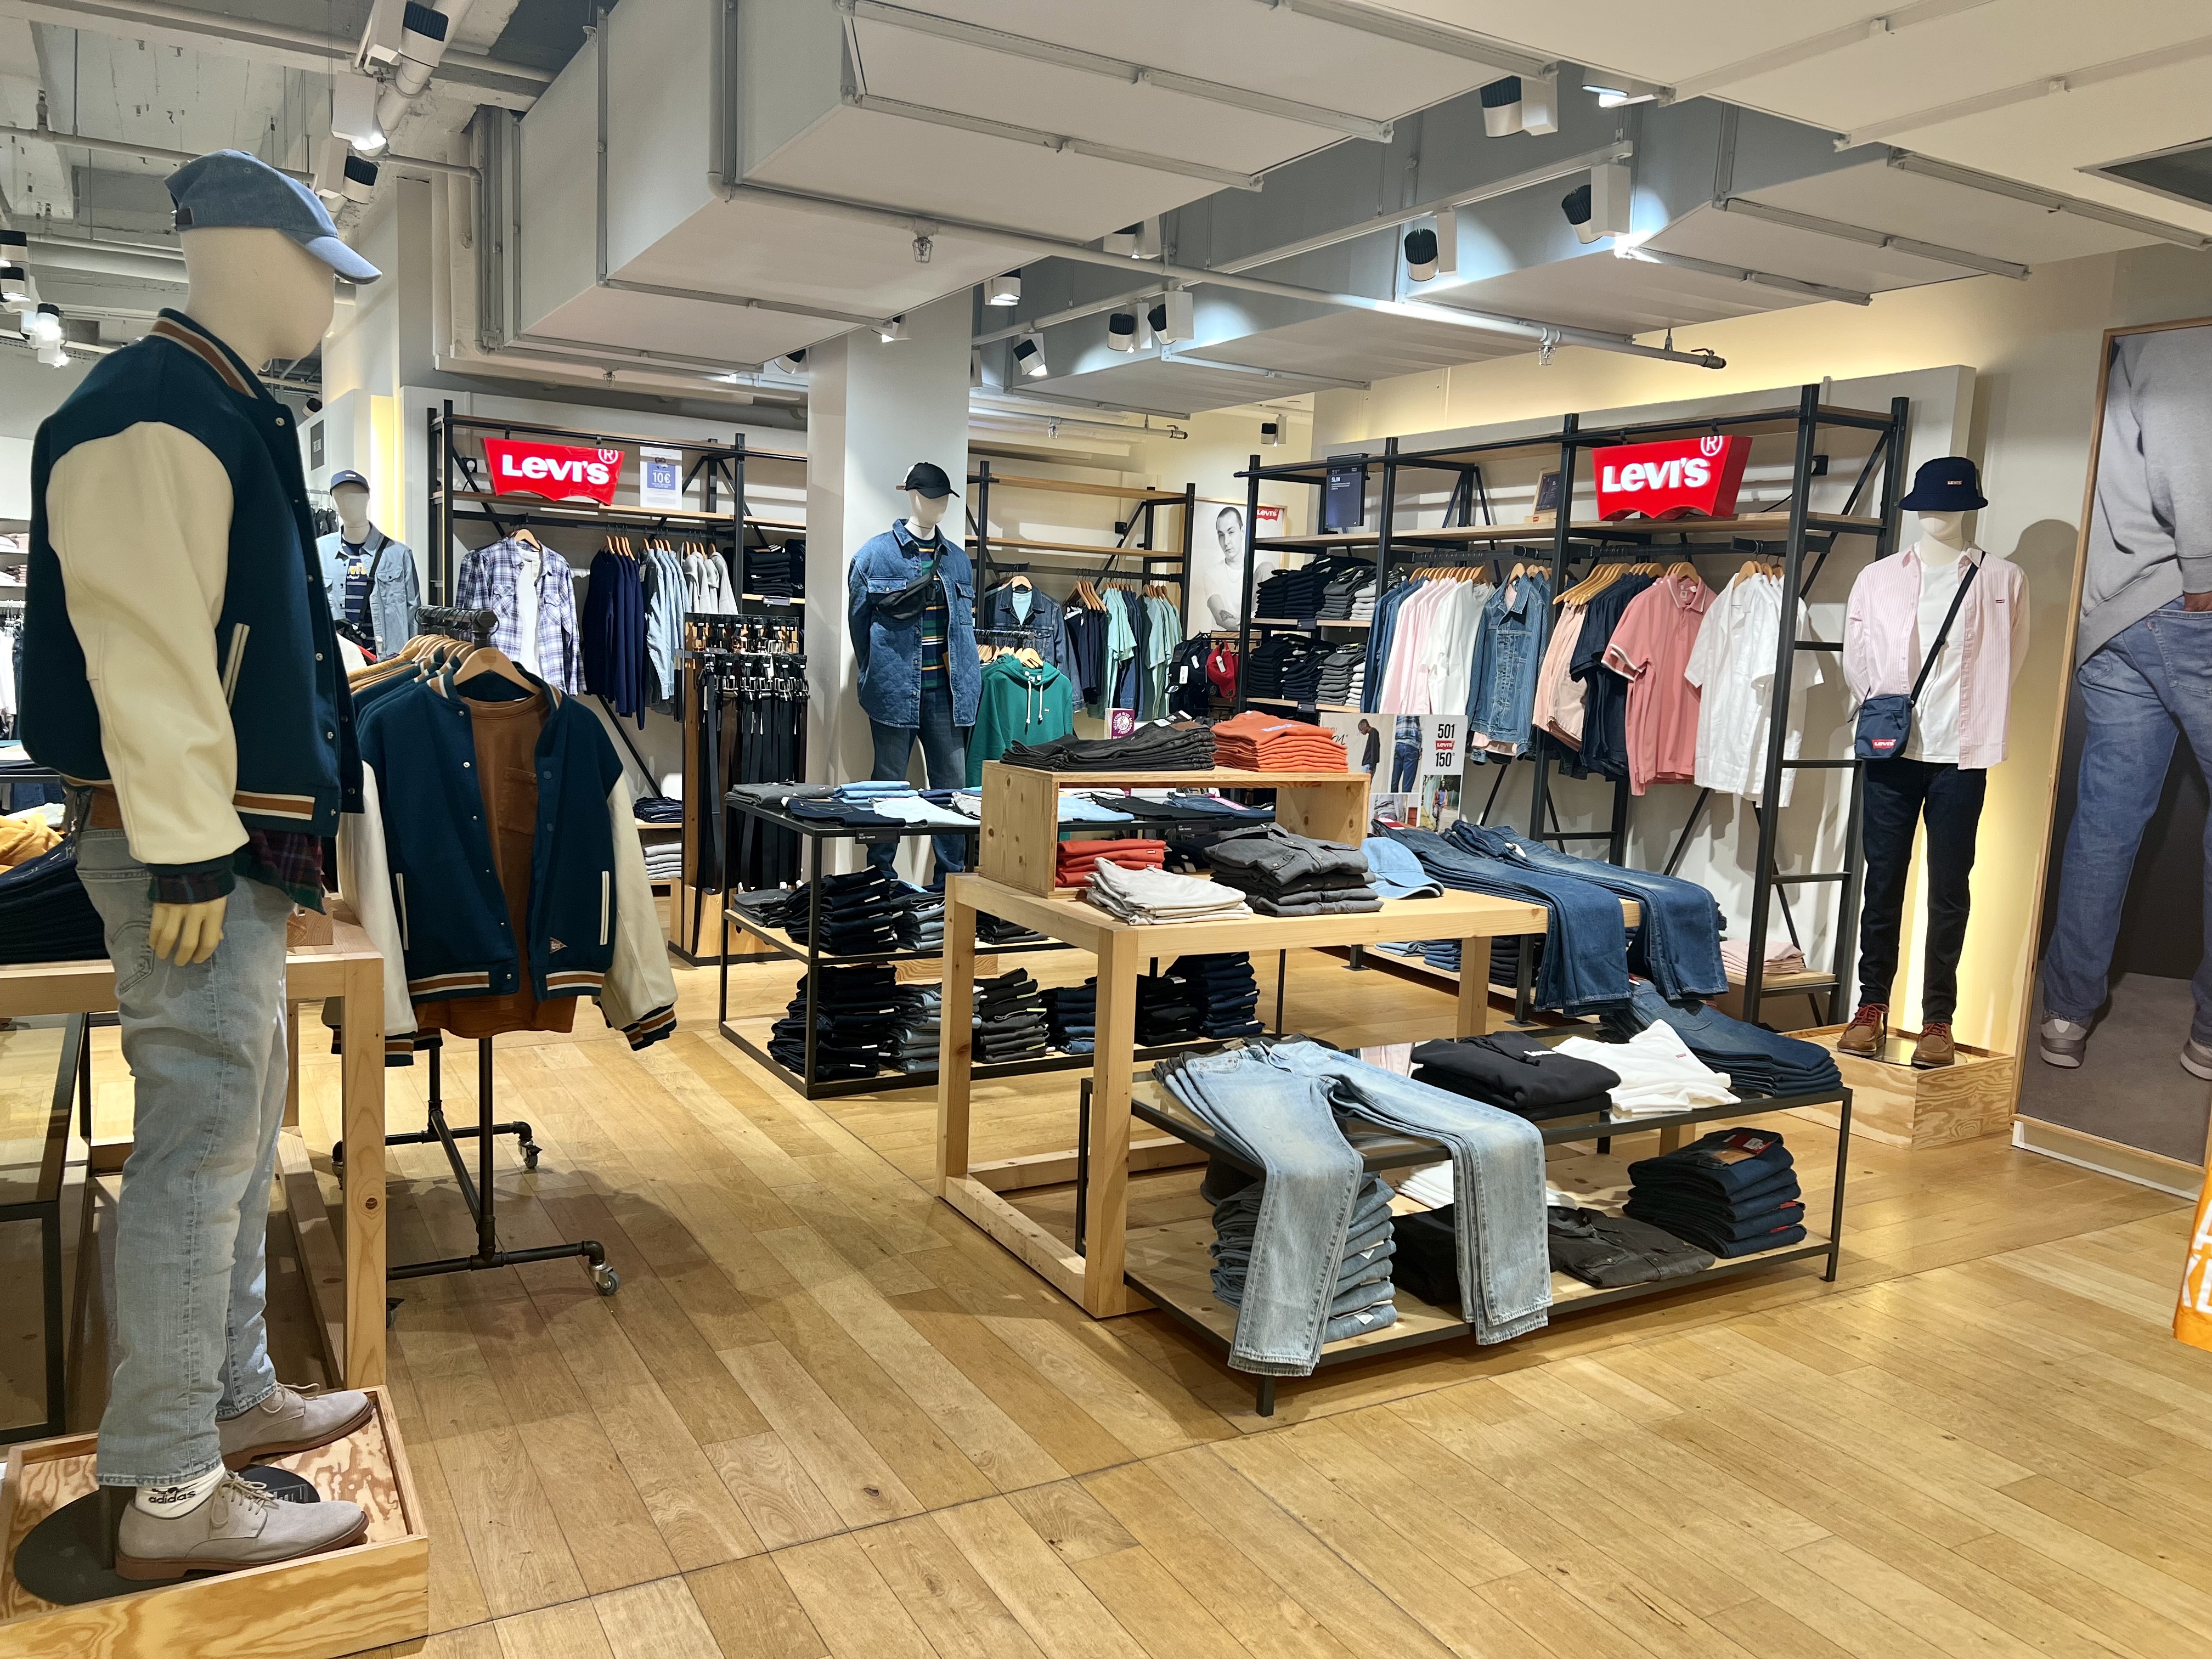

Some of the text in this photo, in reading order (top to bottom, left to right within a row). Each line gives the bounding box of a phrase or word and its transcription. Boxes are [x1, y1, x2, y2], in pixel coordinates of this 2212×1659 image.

[652, 472, 671, 484] 10€
[1437, 724, 1455, 738] 501
[1435, 752, 1452, 767] 150
[149, 1491, 196, 1504] adidas
